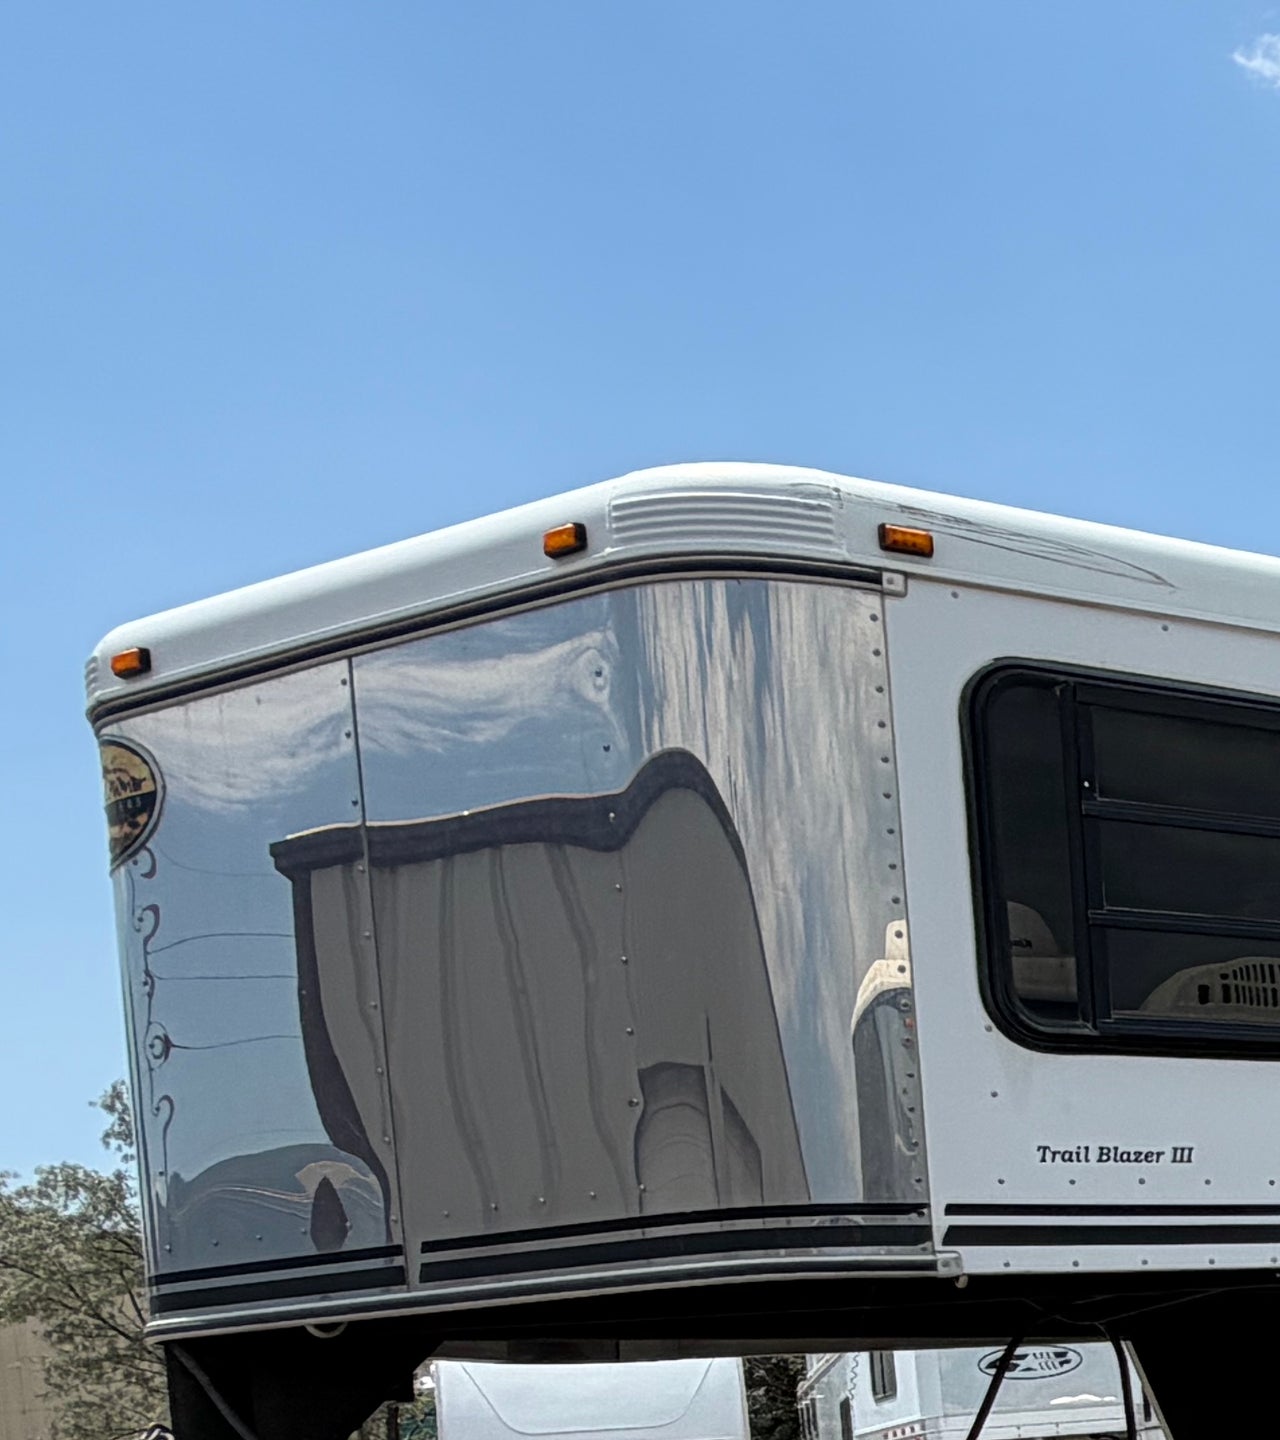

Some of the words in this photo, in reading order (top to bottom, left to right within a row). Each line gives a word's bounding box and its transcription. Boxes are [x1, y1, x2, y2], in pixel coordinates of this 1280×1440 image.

[1037, 1145, 1090, 1163] Trail
[1096, 1146, 1165, 1163] Blazer
[1171, 1147, 1194, 1163] III
